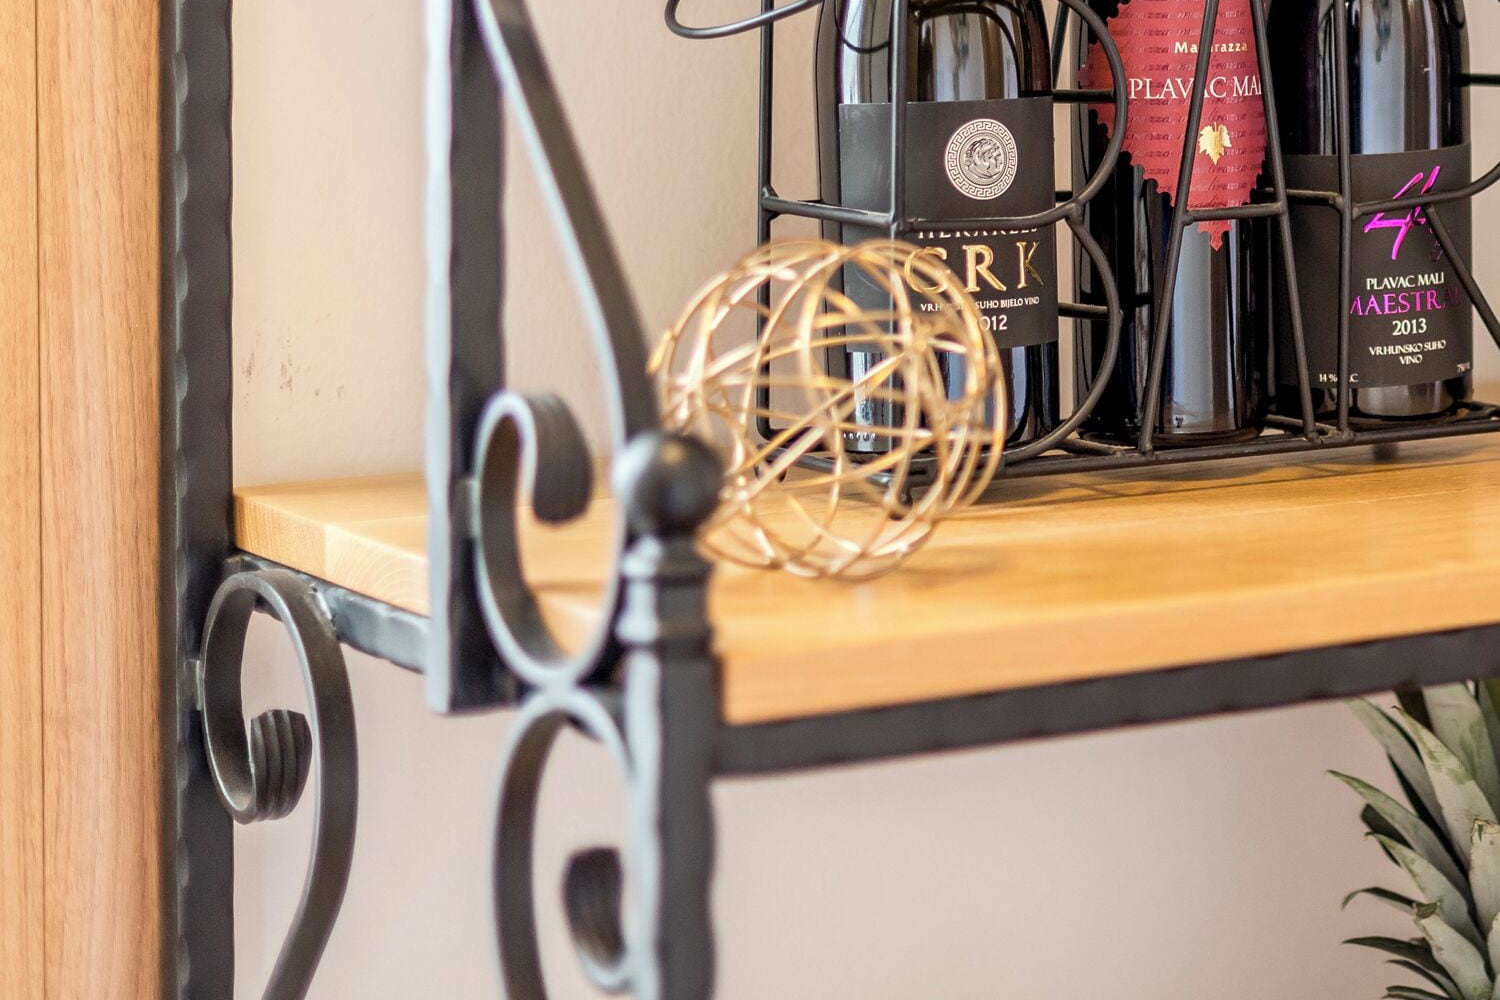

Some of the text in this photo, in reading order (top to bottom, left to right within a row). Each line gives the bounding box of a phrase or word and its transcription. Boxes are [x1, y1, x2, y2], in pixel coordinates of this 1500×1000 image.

[1366, 272, 1445, 290] PLAVAC MALI
[976, 299, 999, 310] SUHO
[1001, 297, 1023, 309] BIJELO
[1025, 296, 1040, 306] VINO
[979, 314, 1008, 331] 012
[1392, 318, 1427, 336] 2013
[1369, 339, 1447, 356] VRHUNSKO SUHO
[1399, 354, 1423, 365] VINO
